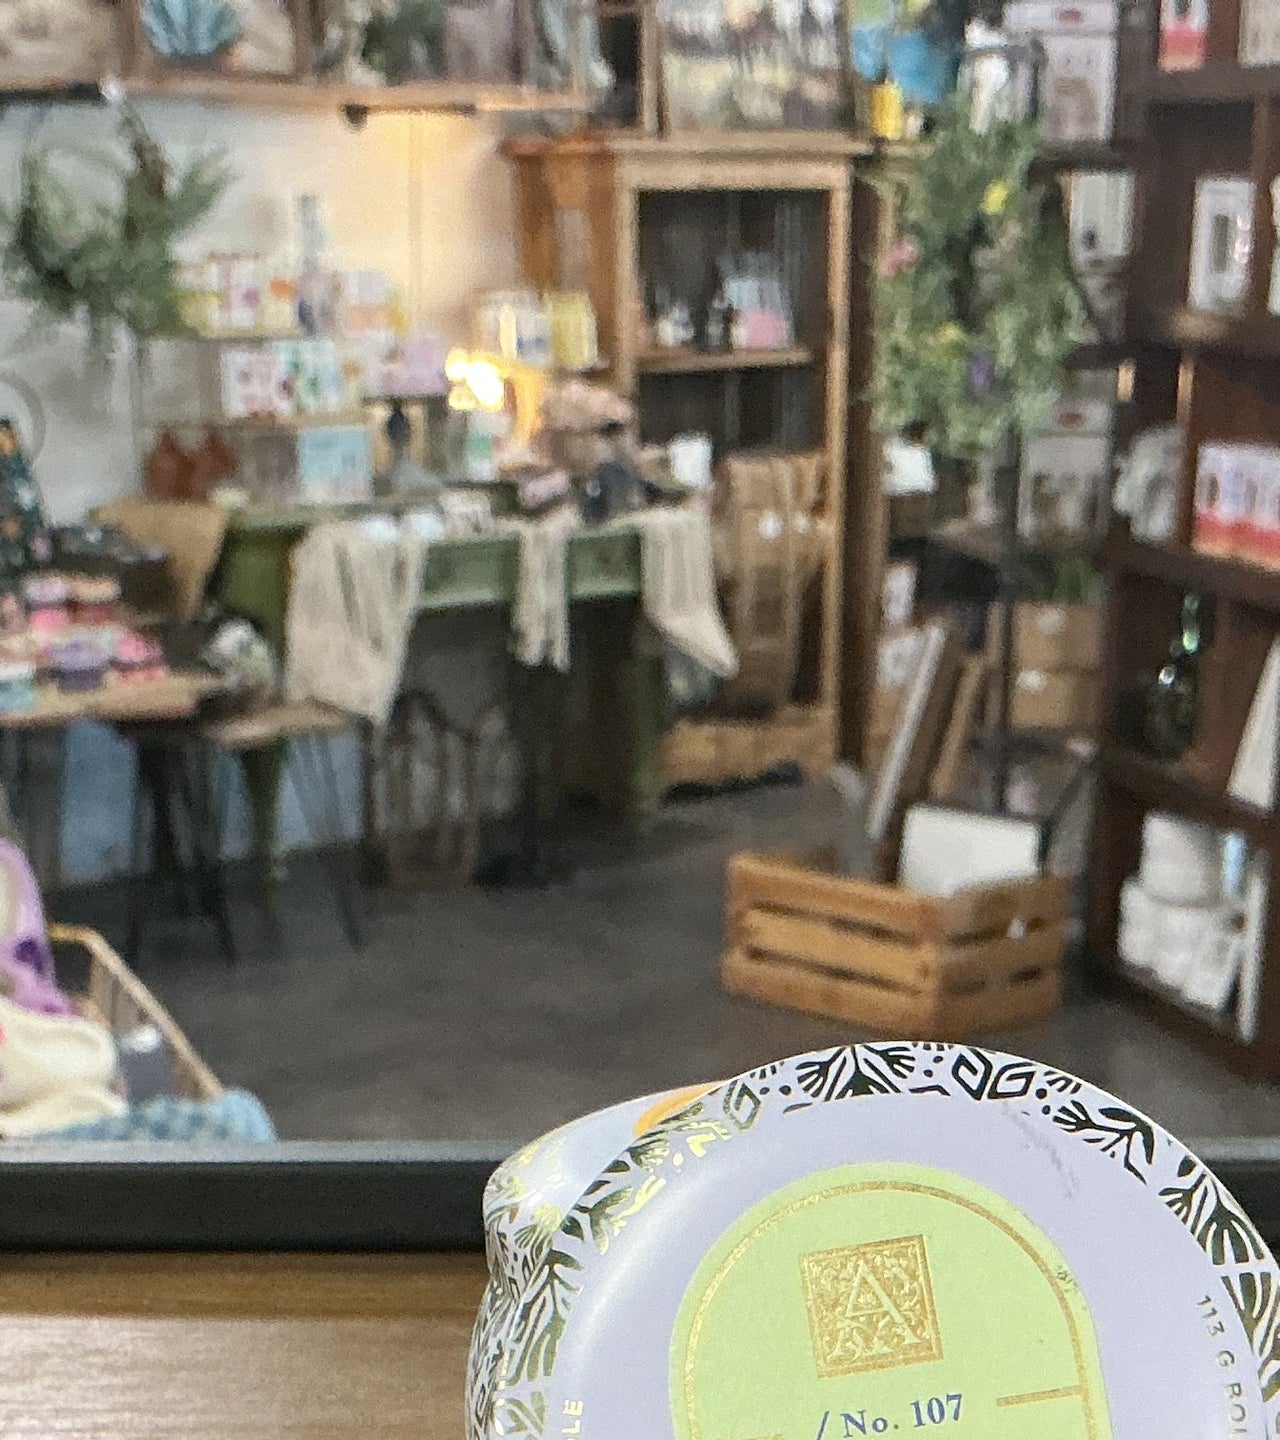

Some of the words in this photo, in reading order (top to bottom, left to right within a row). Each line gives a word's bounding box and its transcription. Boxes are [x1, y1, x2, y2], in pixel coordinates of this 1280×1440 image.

[1196, 1295, 1225, 1339] 113
[1218, 1349, 1235, 1367] G
[840, 1409, 899, 1438] No.
[910, 1393, 962, 1427] 107
